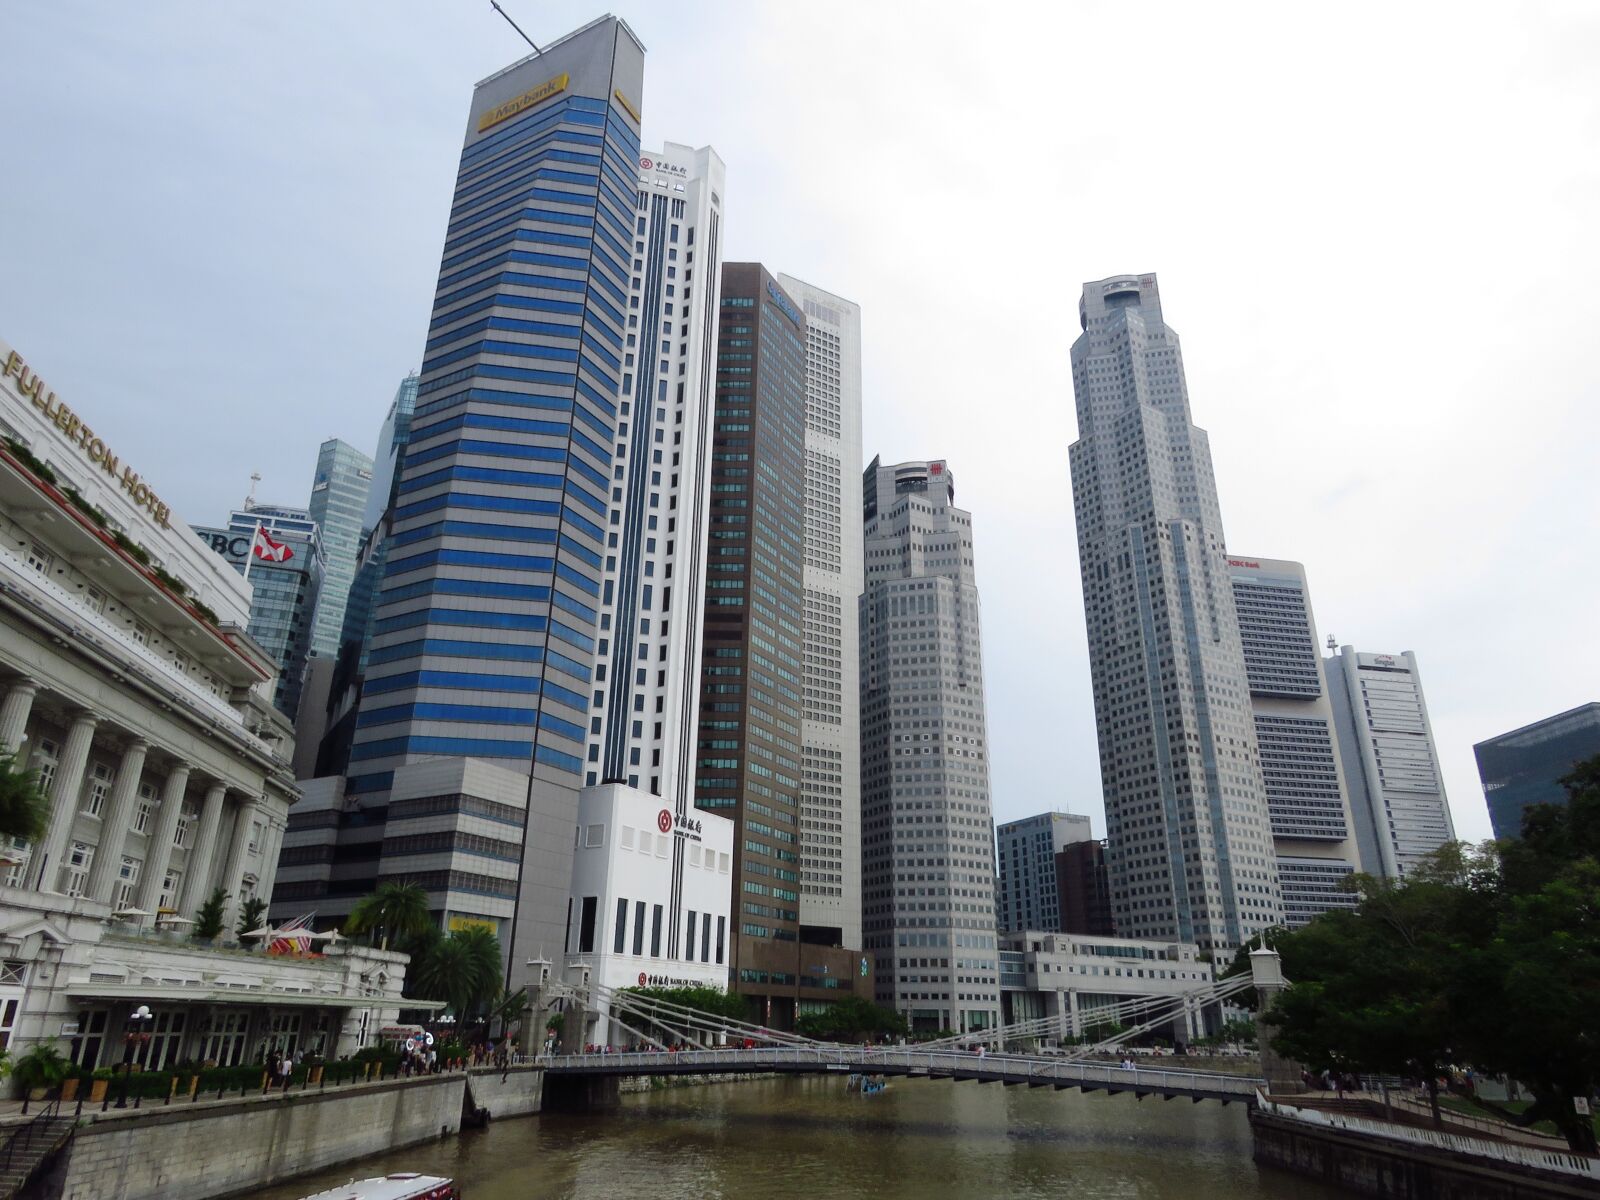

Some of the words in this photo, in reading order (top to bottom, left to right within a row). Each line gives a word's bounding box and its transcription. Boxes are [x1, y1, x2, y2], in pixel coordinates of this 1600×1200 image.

[495, 82, 556, 119] Maybank
[3, 350, 119, 478] FULLERTON
[121, 466, 172, 530] HOTEL
